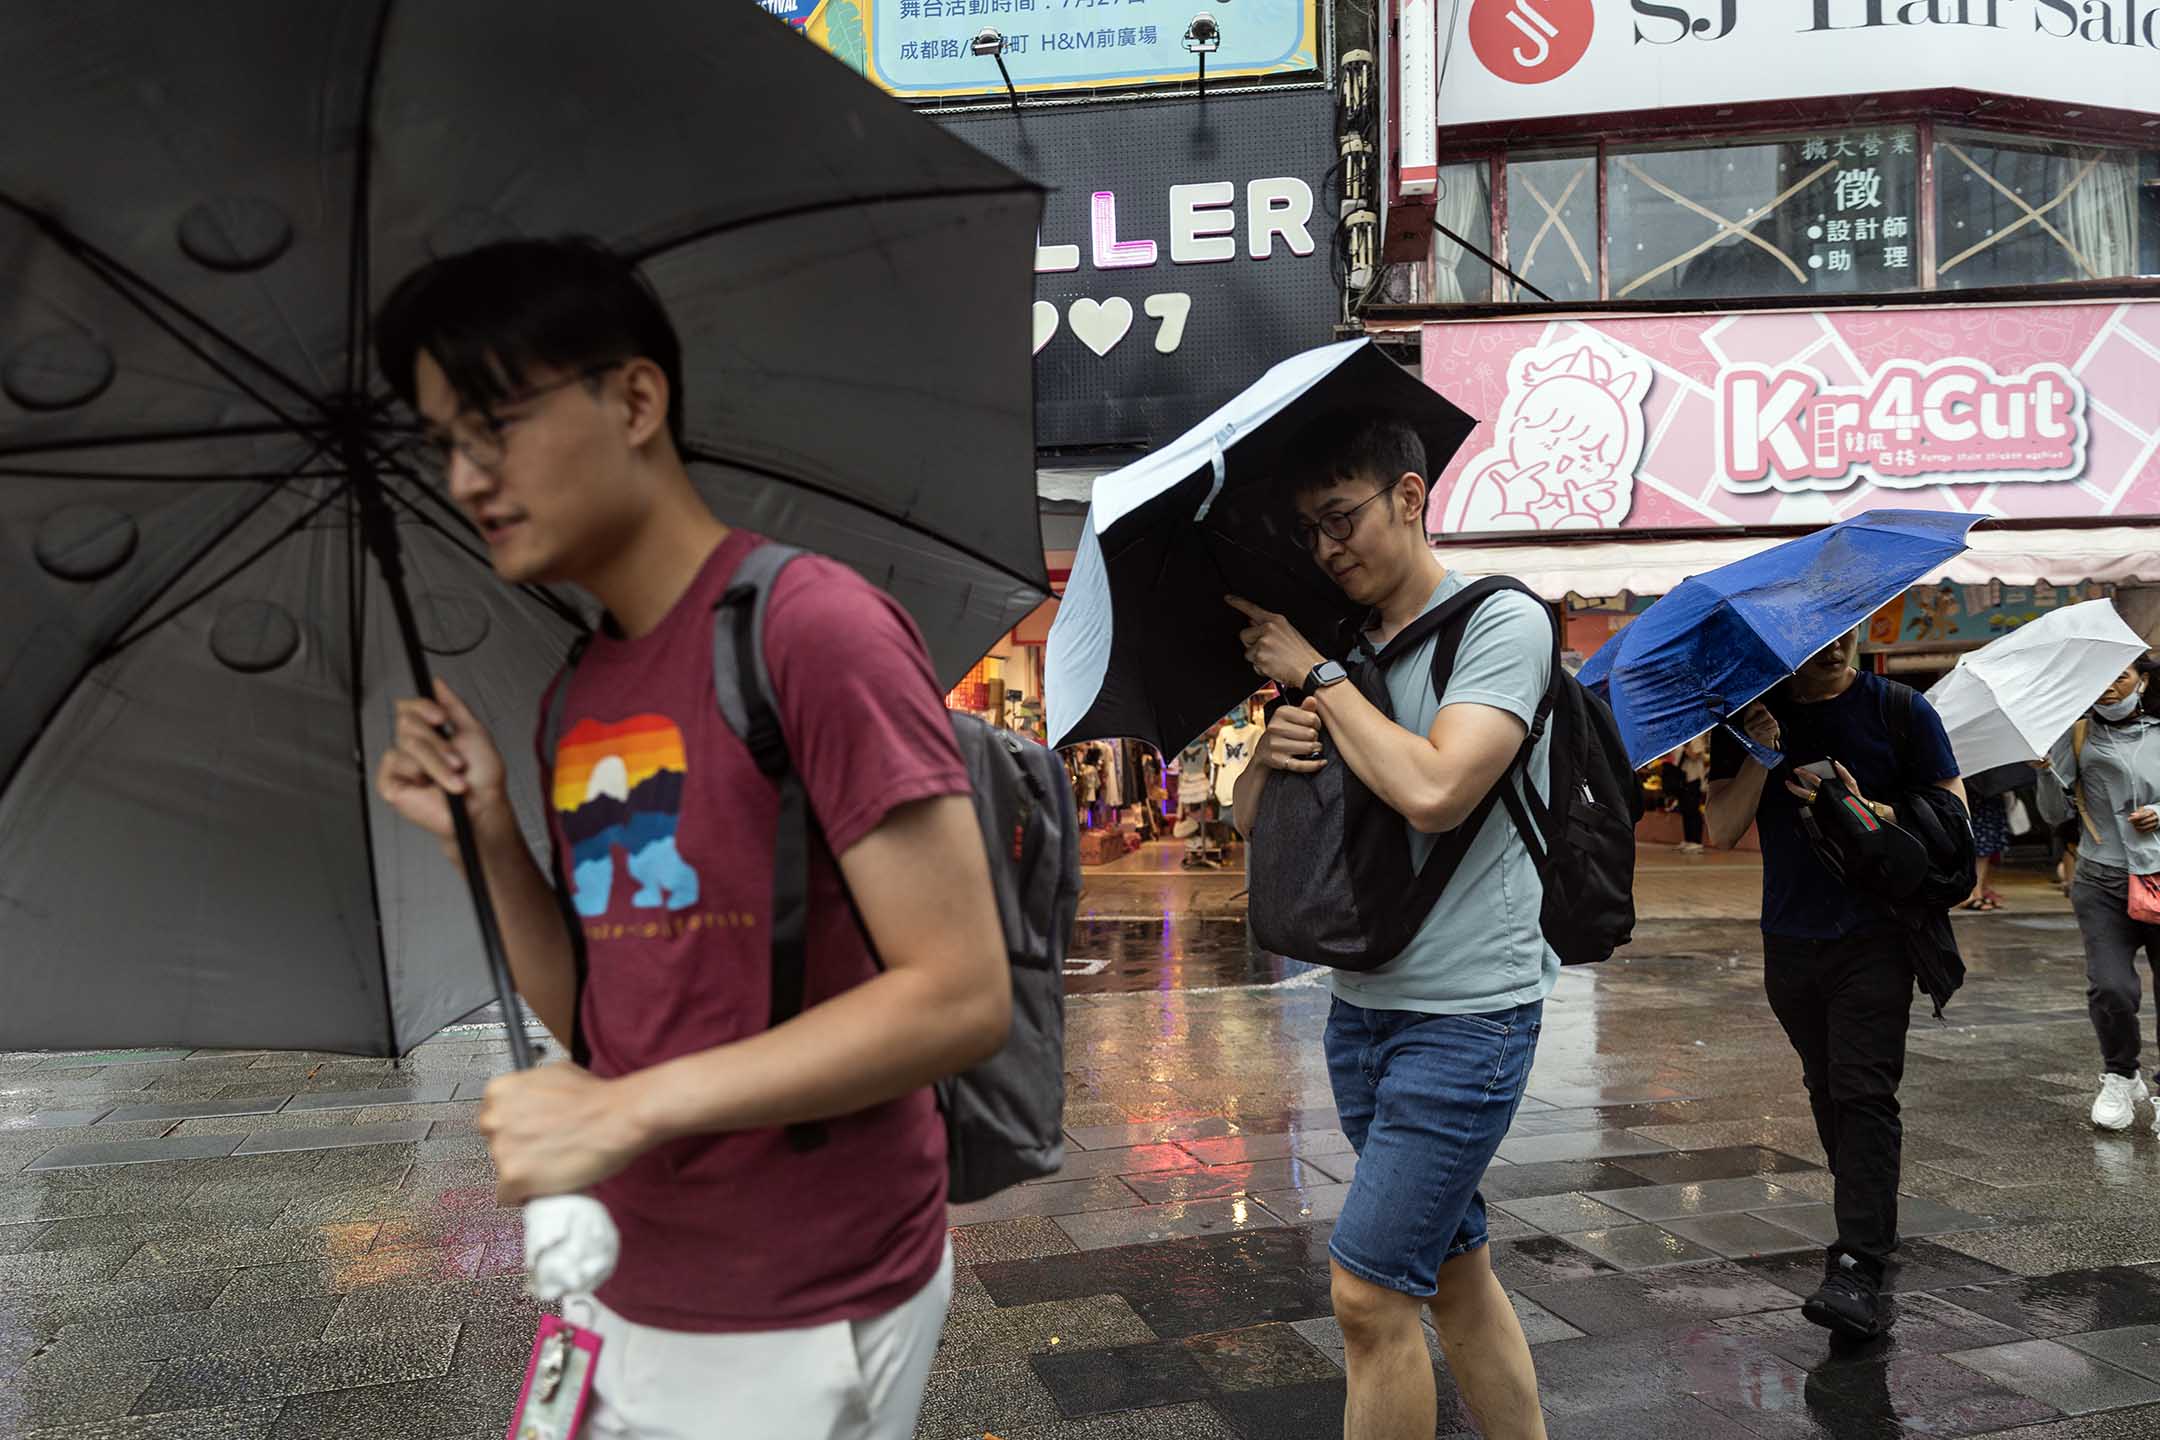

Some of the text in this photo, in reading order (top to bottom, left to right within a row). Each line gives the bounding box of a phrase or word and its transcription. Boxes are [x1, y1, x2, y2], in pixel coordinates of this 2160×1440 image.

[900, 25, 1158, 60] 成都路/町 H&M前廣場
[1834, 167, 1882, 212] 徵
[1826, 216, 1908, 243] 設計師
[1733, 374, 2067, 472] Kr4Cut
